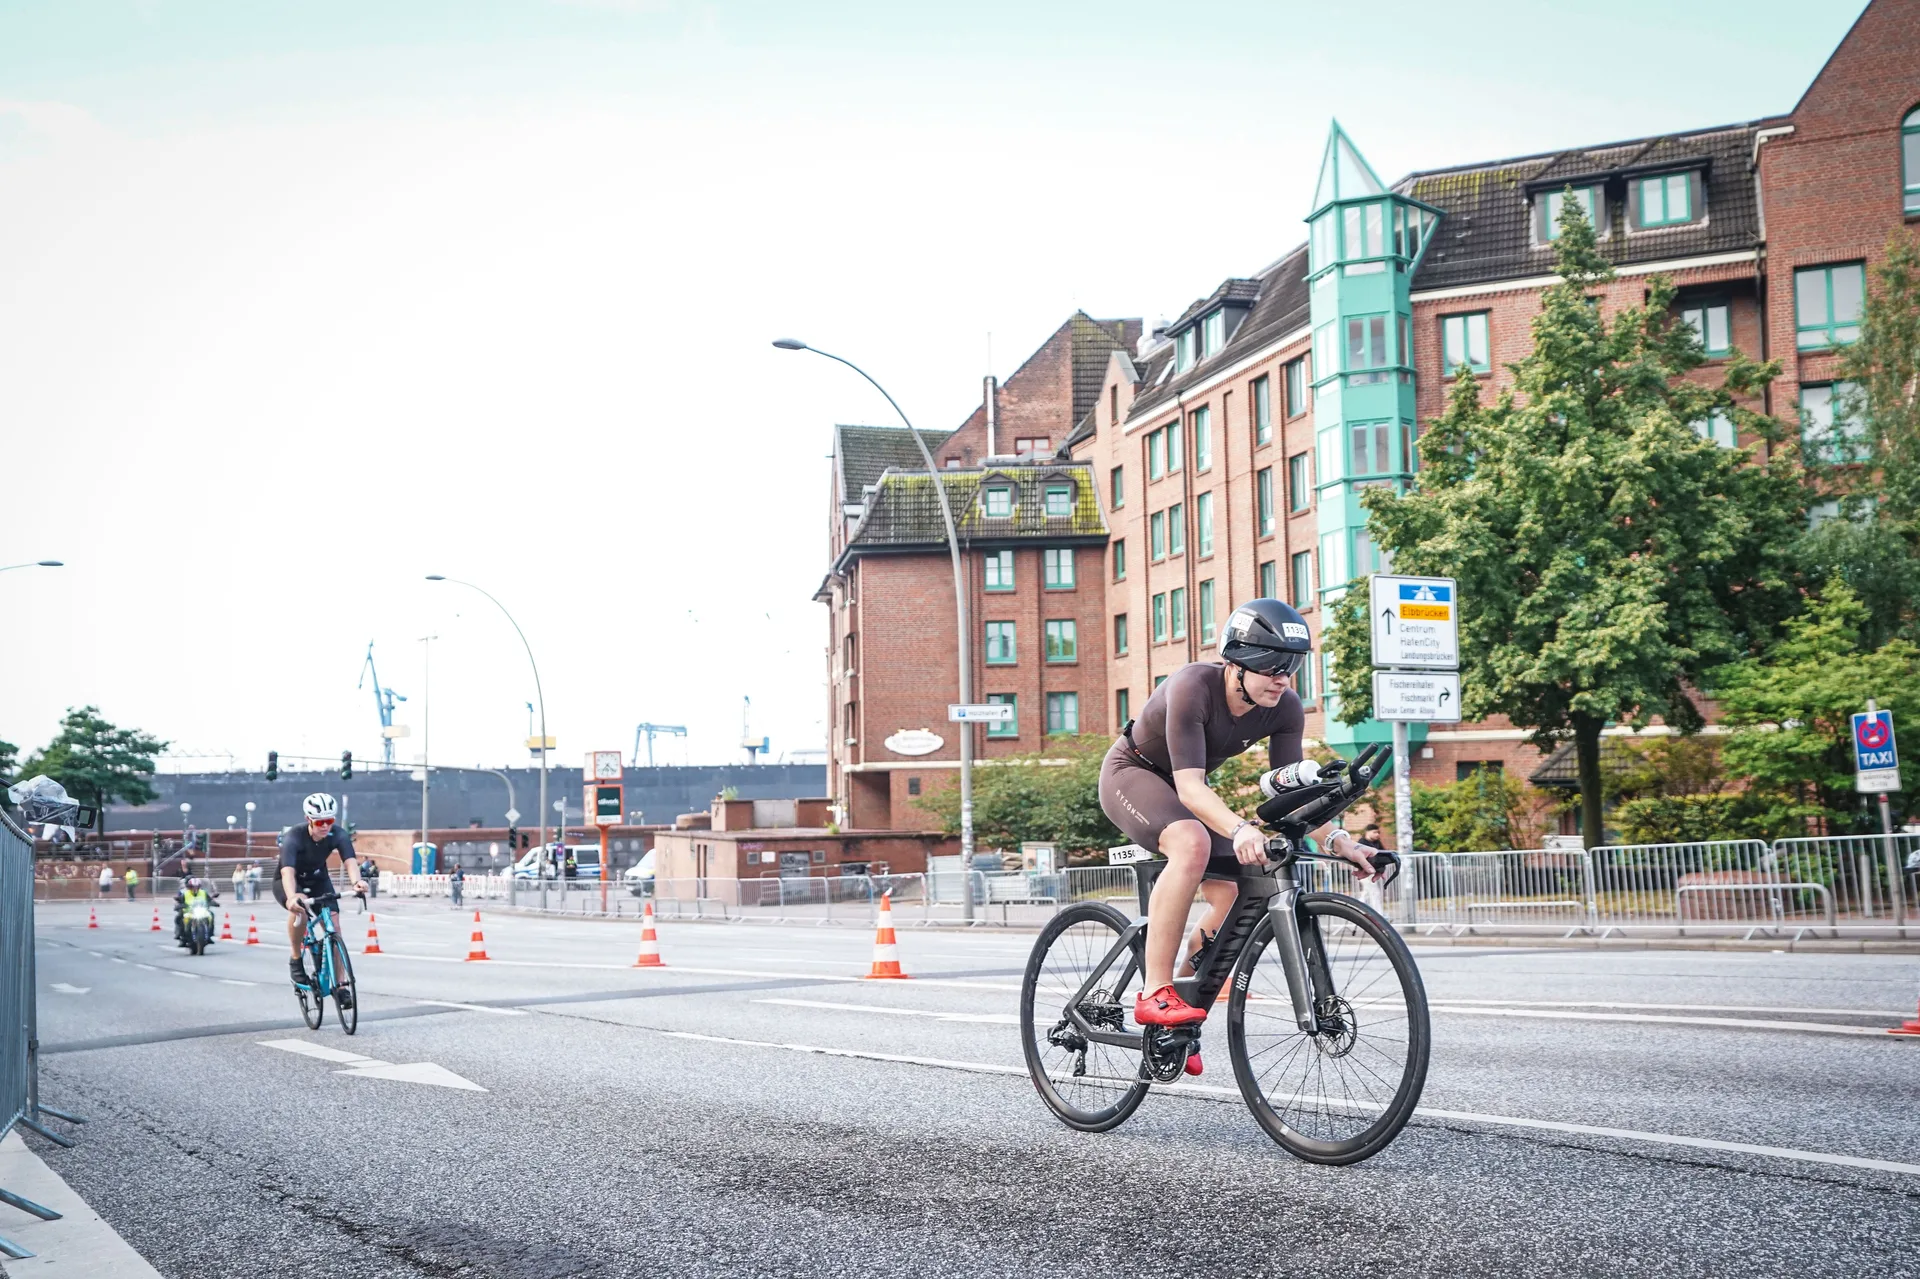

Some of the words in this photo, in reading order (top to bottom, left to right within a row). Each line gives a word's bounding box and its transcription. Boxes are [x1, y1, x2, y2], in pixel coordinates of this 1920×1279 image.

[1400, 623, 1436, 634] Centrum
[1400, 637, 1441, 649] HafenCity
[1400, 692, 1435, 702] Fischmarkt
[1860, 751, 1893, 766] TAXI
[1115, 789, 1137, 815] RYZON
[1198, 896, 1264, 995] CANYON
